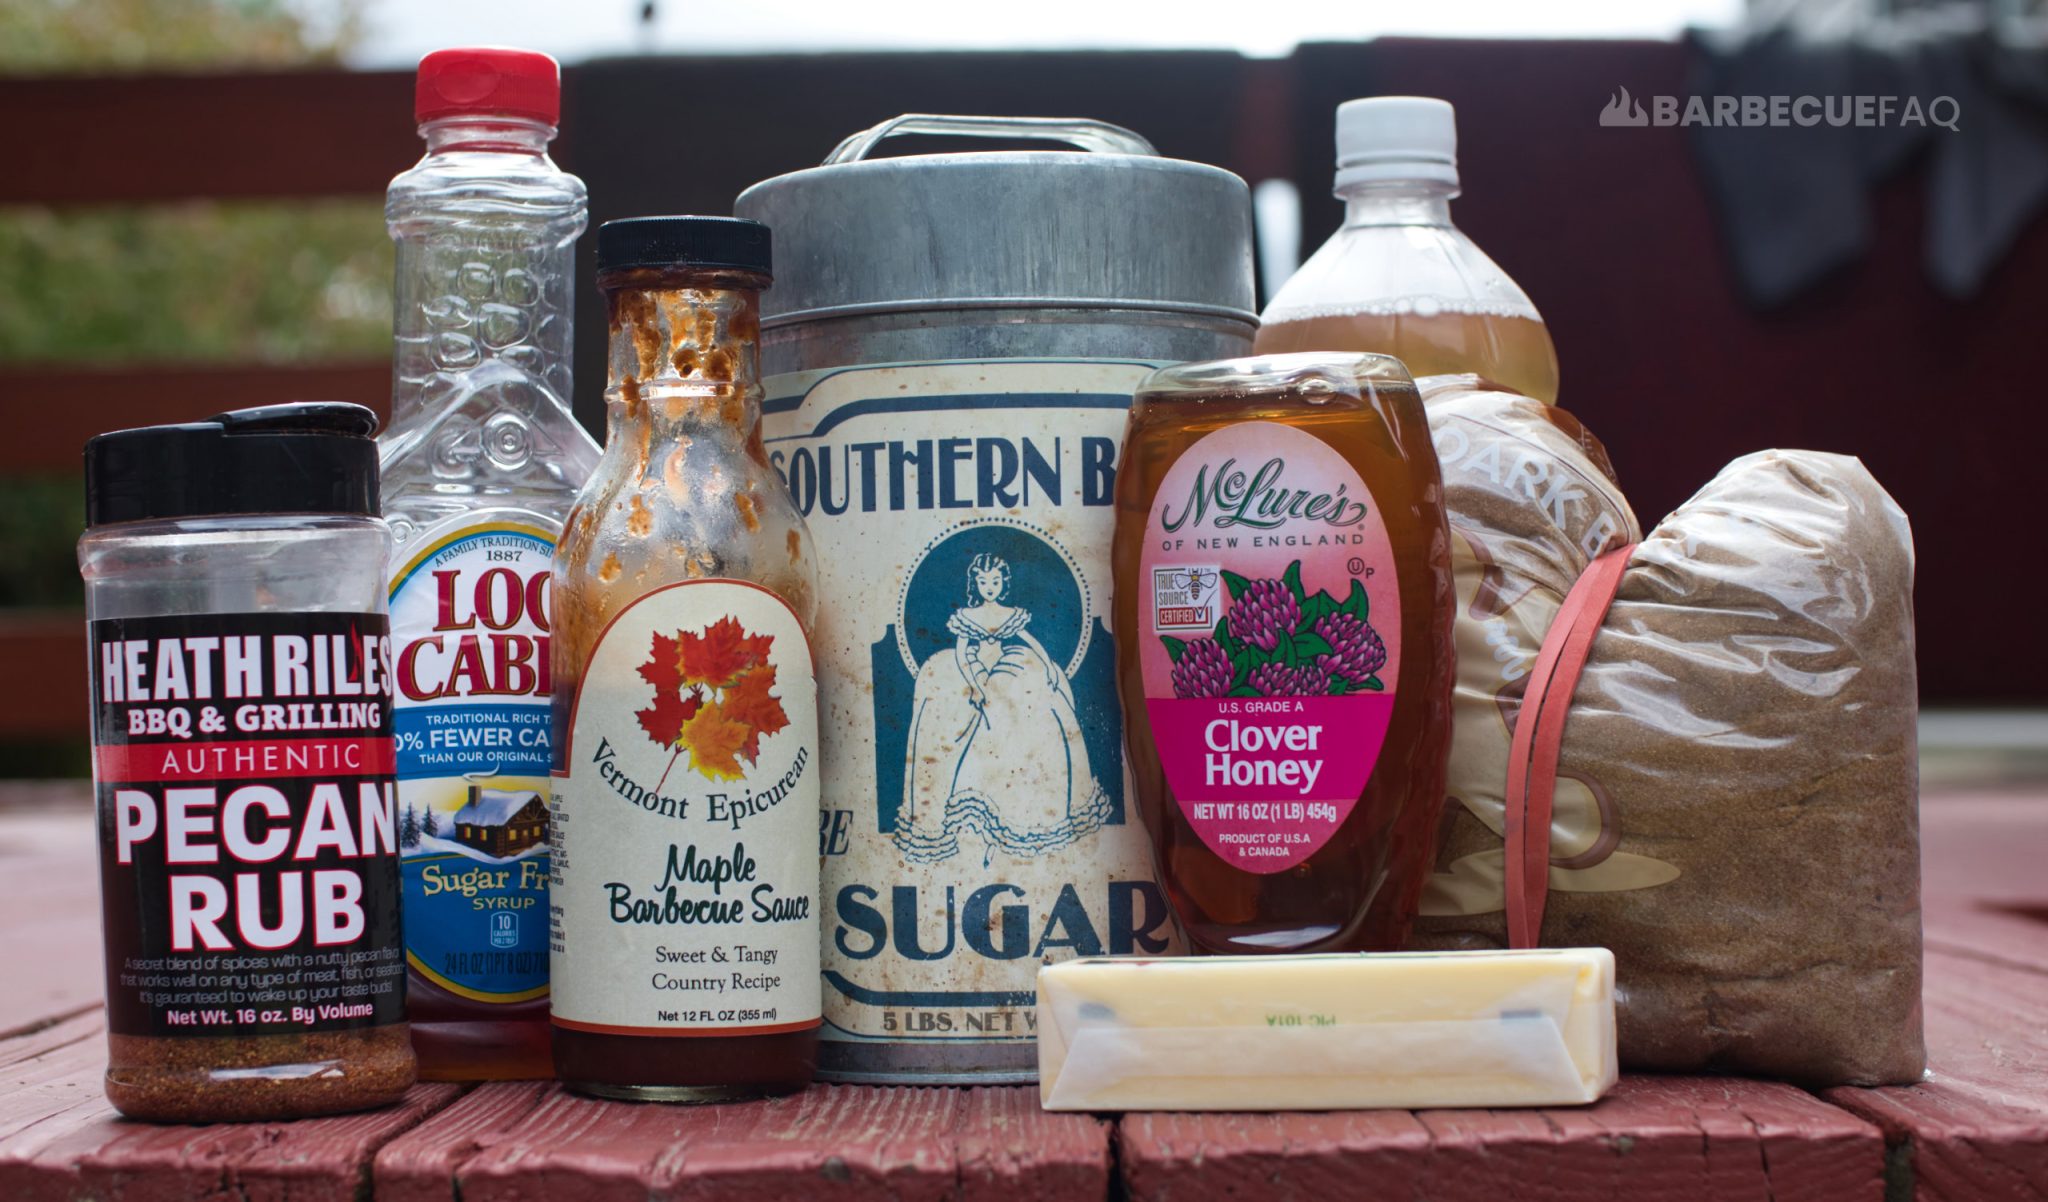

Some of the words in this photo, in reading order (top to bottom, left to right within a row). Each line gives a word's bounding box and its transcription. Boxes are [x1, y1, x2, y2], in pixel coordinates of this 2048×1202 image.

[1162, 458, 1367, 533] McLure's
[435, 557, 443, 568] A
[441, 539, 478, 562] FAMILY
[480, 536, 539, 552] TRADITION
[1162, 540, 1184, 551] OF
[1197, 538, 1239, 549] NEW
[1254, 534, 1364, 547] ENGLAND
[487, 550, 523, 562] 1887
[1157, 573, 1175, 590] TRUE
[1159, 591, 1188, 605] SOURCE
[1161, 610, 1194, 623] CERTIFIED
[102, 635, 262, 702] HEATH
[274, 634, 392, 697] RILES
[1219, 703, 1241, 713] U.S.
[1245, 702, 1290, 712] GRADE
[1294, 701, 1304, 711] A
[128, 707, 193, 739] BBQ
[199, 706, 227, 733] &
[235, 703, 381, 732] GRILLING
[426, 713, 509, 725] TRADITIONAL
[512, 714, 540, 724] RICH
[429, 727, 513, 749] FEWER
[1204, 719, 1323, 752] Clover
[161, 743, 361, 774] AUTHENTIC
[419, 753, 453, 765] THAN
[457, 752, 484, 762] OUR
[486, 751, 544, 763] ORIGINAL
[592, 737, 689, 820] Vermont
[706, 746, 809, 830] Epicurean
[1205, 753, 1324, 794] Honey
[114, 781, 397, 866] PECAN
[1193, 803, 1214, 820] NET
[1217, 803, 1235, 820] WT
[1237, 803, 1250, 819] 16
[1252, 803, 1268, 819] OZ
[1270, 803, 1281, 822] (1
[1284, 803, 1304, 822] LB)
[1307, 803, 1337, 822] 454g
[1219, 833, 1265, 844] PRODUCT
[1267, 833, 1281, 843] OF
[1284, 833, 1311, 843] U.S.A
[1239, 847, 1246, 856] &
[1248, 847, 1290, 857] CANADA
[422, 864, 510, 897] Sugar
[518, 861, 550, 890] Fr
[654, 842, 756, 895] Maple
[169, 869, 365, 952] RUB
[472, 897, 535, 910] SYRUP
[603, 882, 744, 925] Barbecue
[751, 883, 809, 923] Sauce
[498, 915, 511, 930] 10
[835, 881, 1170, 961] SUGAR
[125, 957, 132, 968] A
[133, 958, 164, 970] secret
[166, 956, 202, 970] blend
[204, 956, 219, 970] of
[221, 956, 269, 972] spices
[272, 954, 301, 967] with
[304, 955, 313, 965] a
[316, 952, 348, 966] nutty
[350, 950, 380, 965] pecan
[444, 952, 457, 975] 24
[459, 952, 469, 975] FL
[471, 952, 484, 975] OZ
[655, 946, 706, 963] Sweet
[711, 947, 729, 963] &
[734, 946, 779, 965] Tangy
[139, 975, 170, 987] works
[172, 974, 197, 987] well
[200, 975, 218, 987] on
[220, 975, 249, 989] any
[250, 973, 284, 988] type
[287, 971, 302, 983] of
[365, 967, 375, 978] or
[652, 973, 726, 993] Country
[732, 973, 781, 991] Recipe
[230, 990, 245, 1003] to
[247, 988, 286, 1002] wake
[288, 989, 307, 1003] up
[310, 986, 339, 1003] your
[341, 984, 369, 997] taste
[167, 1009, 197, 1024] Net
[200, 1009, 233, 1024] Wt.
[236, 1009, 256, 1023] 16
[260, 1010, 287, 1023] oz.
[292, 1006, 315, 1025] By
[318, 1001, 373, 1019] Volume
[658, 1010, 679, 1022] Net
[683, 1011, 697, 1022] 12
[700, 1011, 715, 1022] FL
[718, 1010, 735, 1021] OZ
[738, 1009, 760, 1023] (355
[762, 1008, 777, 1021] ml)
[883, 1012, 897, 1031] 5
[905, 1012, 958, 1031] LBS.
[966, 1012, 1014, 1031] NET
